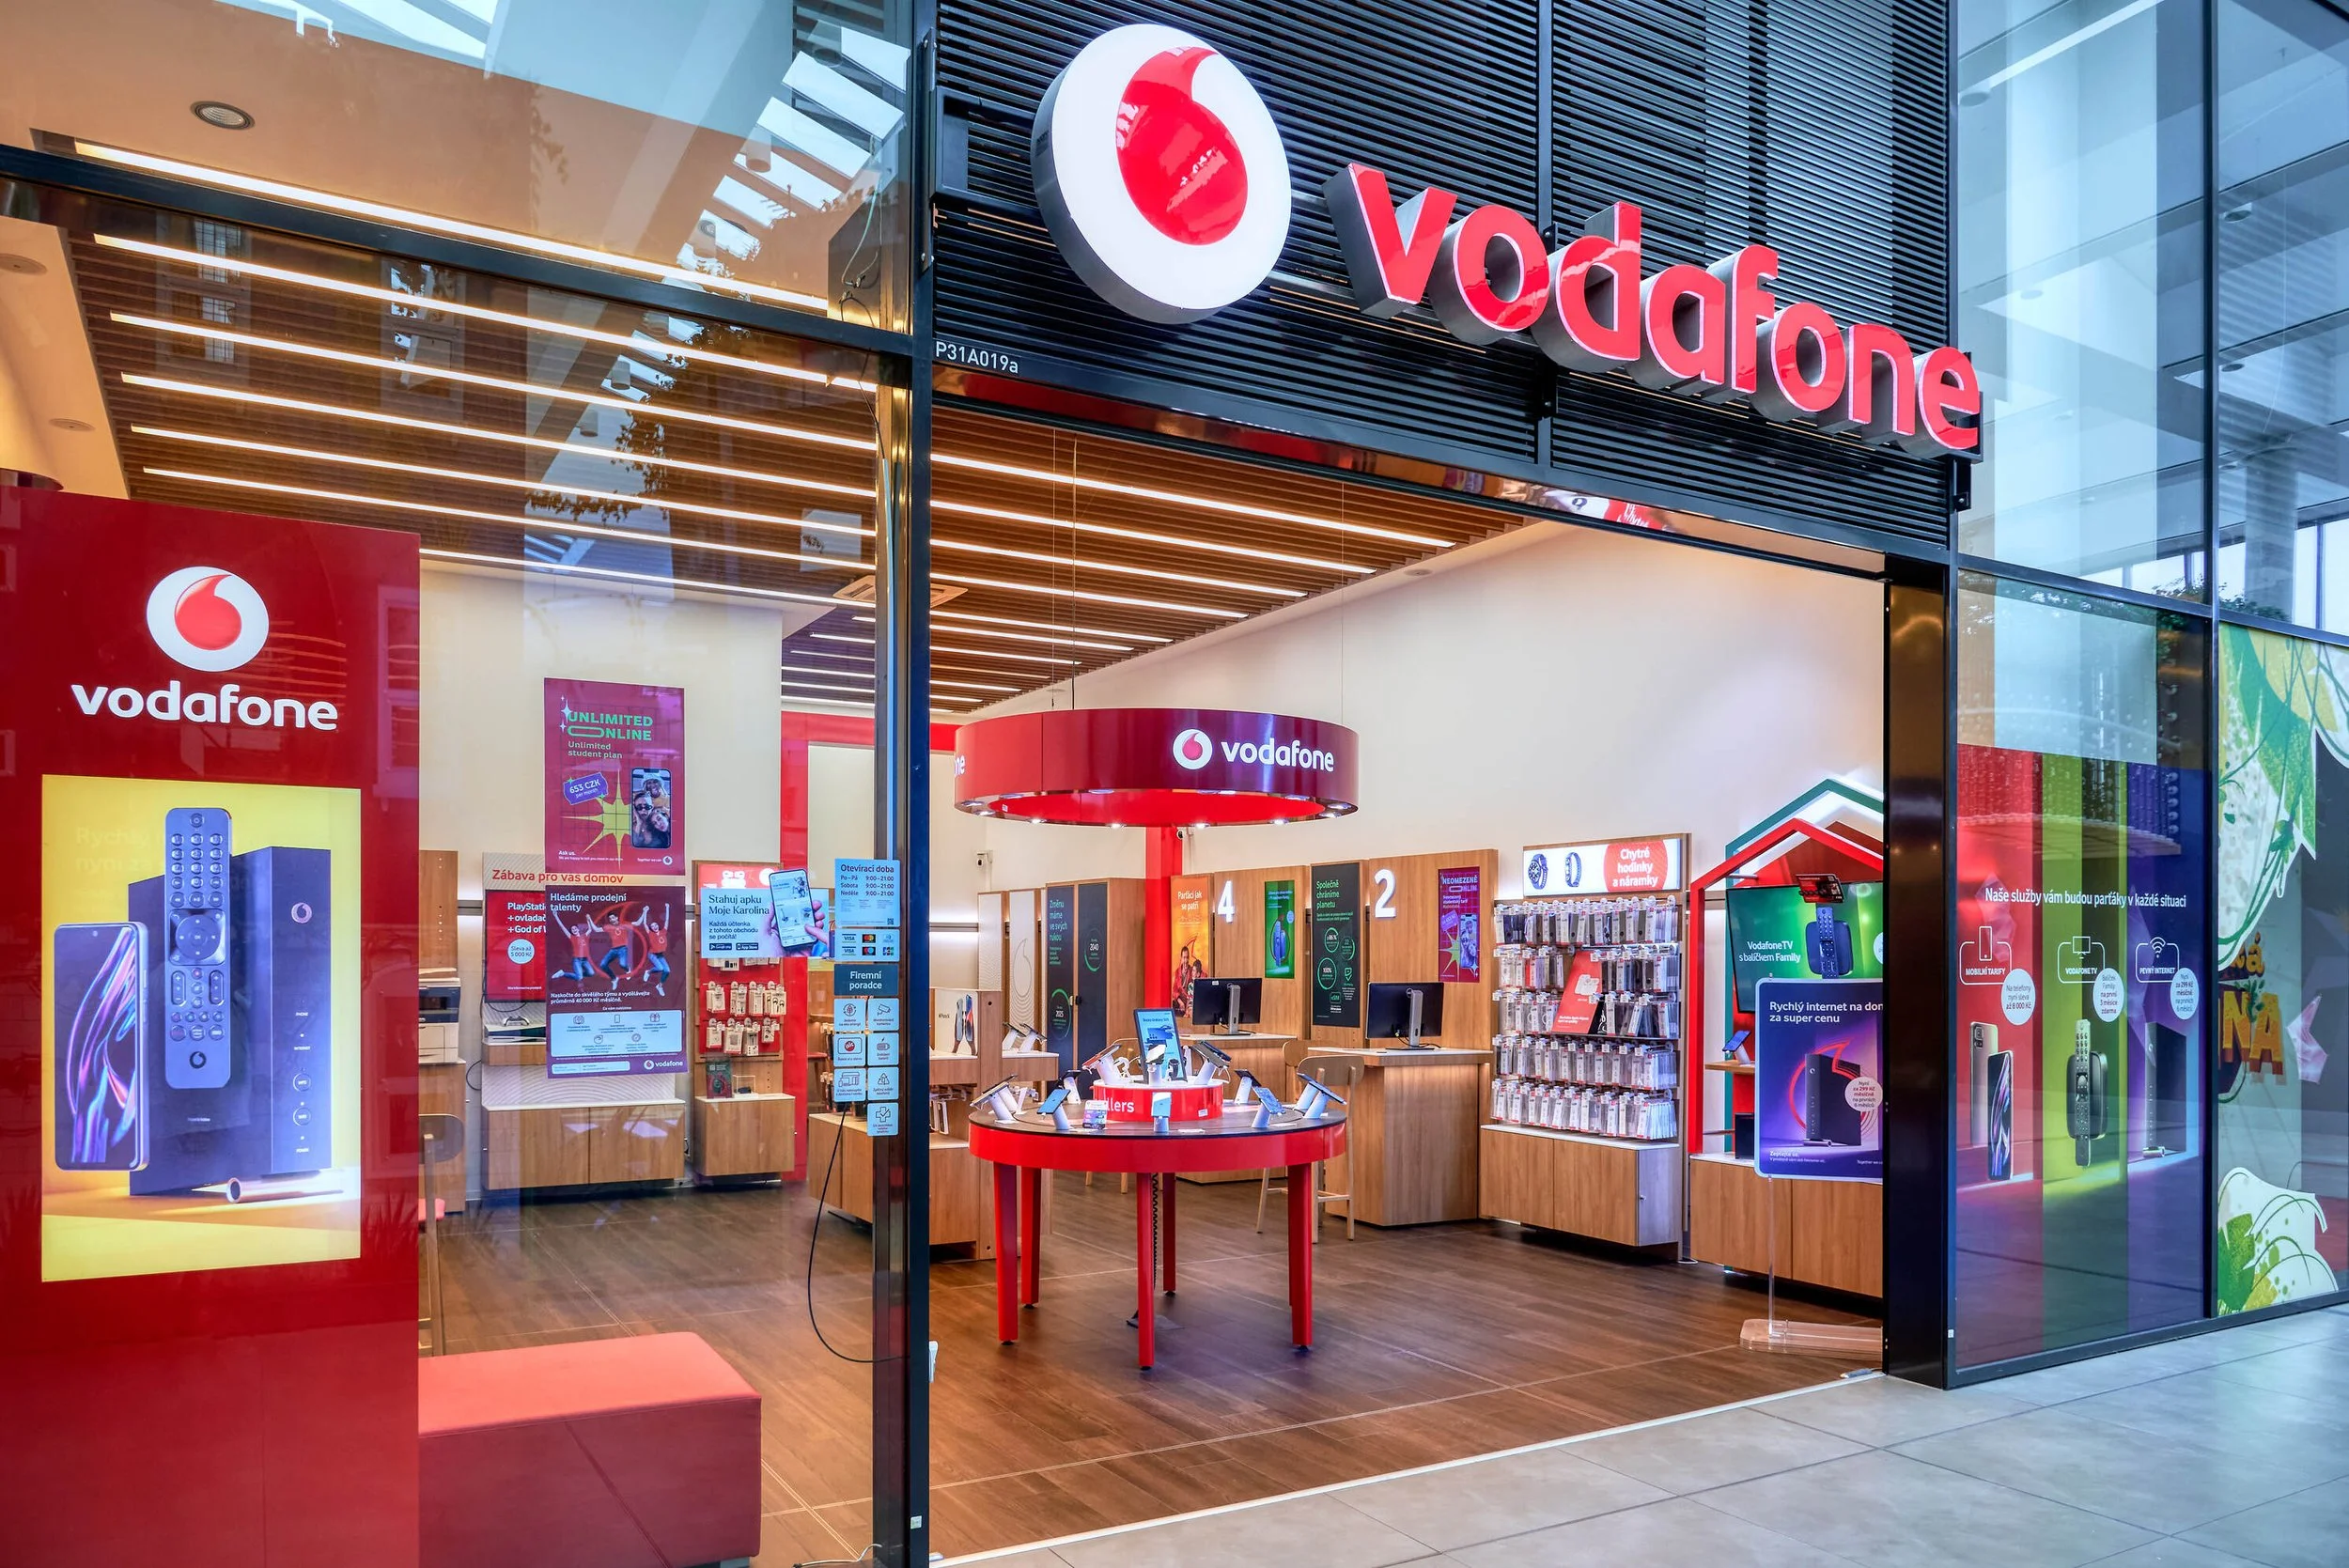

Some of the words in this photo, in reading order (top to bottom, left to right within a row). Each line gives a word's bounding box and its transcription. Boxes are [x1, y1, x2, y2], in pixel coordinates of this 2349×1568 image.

[1346, 162, 1979, 451] vodafone
[936, 341, 1019, 373] P31A019a
[71, 680, 338, 730] vodafone
[568, 712, 653, 726] UNLIMITED
[568, 741, 611, 750] Unlimited
[603, 751, 623, 759] plan
[1221, 737, 1334, 772] vodafone
[569, 784, 583, 794] 653
[1620, 846, 1650, 861] Chytré
[1618, 862, 1653, 874] hodinky
[492, 870, 535, 881] Zábava
[538, 874, 558, 885] pro
[583, 874, 624, 883] domov
[1619, 875, 1658, 887] náramky
[550, 893, 589, 902] Hledáme
[591, 893, 627, 904] prodejní
[1374, 869, 1396, 918] 2
[1985, 887, 2009, 902] Naše
[2011, 888, 2042, 907] služby
[2043, 889, 2062, 903] vám
[2064, 891, 2092, 905] budou
[2094, 891, 2126, 908] parťáky
[2127, 895, 2134, 906] v
[2135, 893, 2159, 907] každé
[2160, 894, 2186, 908] situaci
[708, 894, 739, 905] Stahuj
[739, 895, 762, 906] apku
[1218, 880, 1235, 924] 4
[507, 903, 546, 911] PlayStati
[550, 904, 582, 912] talenty
[708, 906, 731, 916] Moje
[733, 906, 770, 915] Karolina
[1743, 953, 1774, 961] balíčkem
[1776, 954, 1801, 963] Family
[850, 970, 882, 979] Firemní
[849, 981, 882, 990] poradce
[1769, 1001, 1804, 1013] Rychlý
[1806, 1001, 1847, 1011] internet
[1783, 1015, 1812, 1024] super
